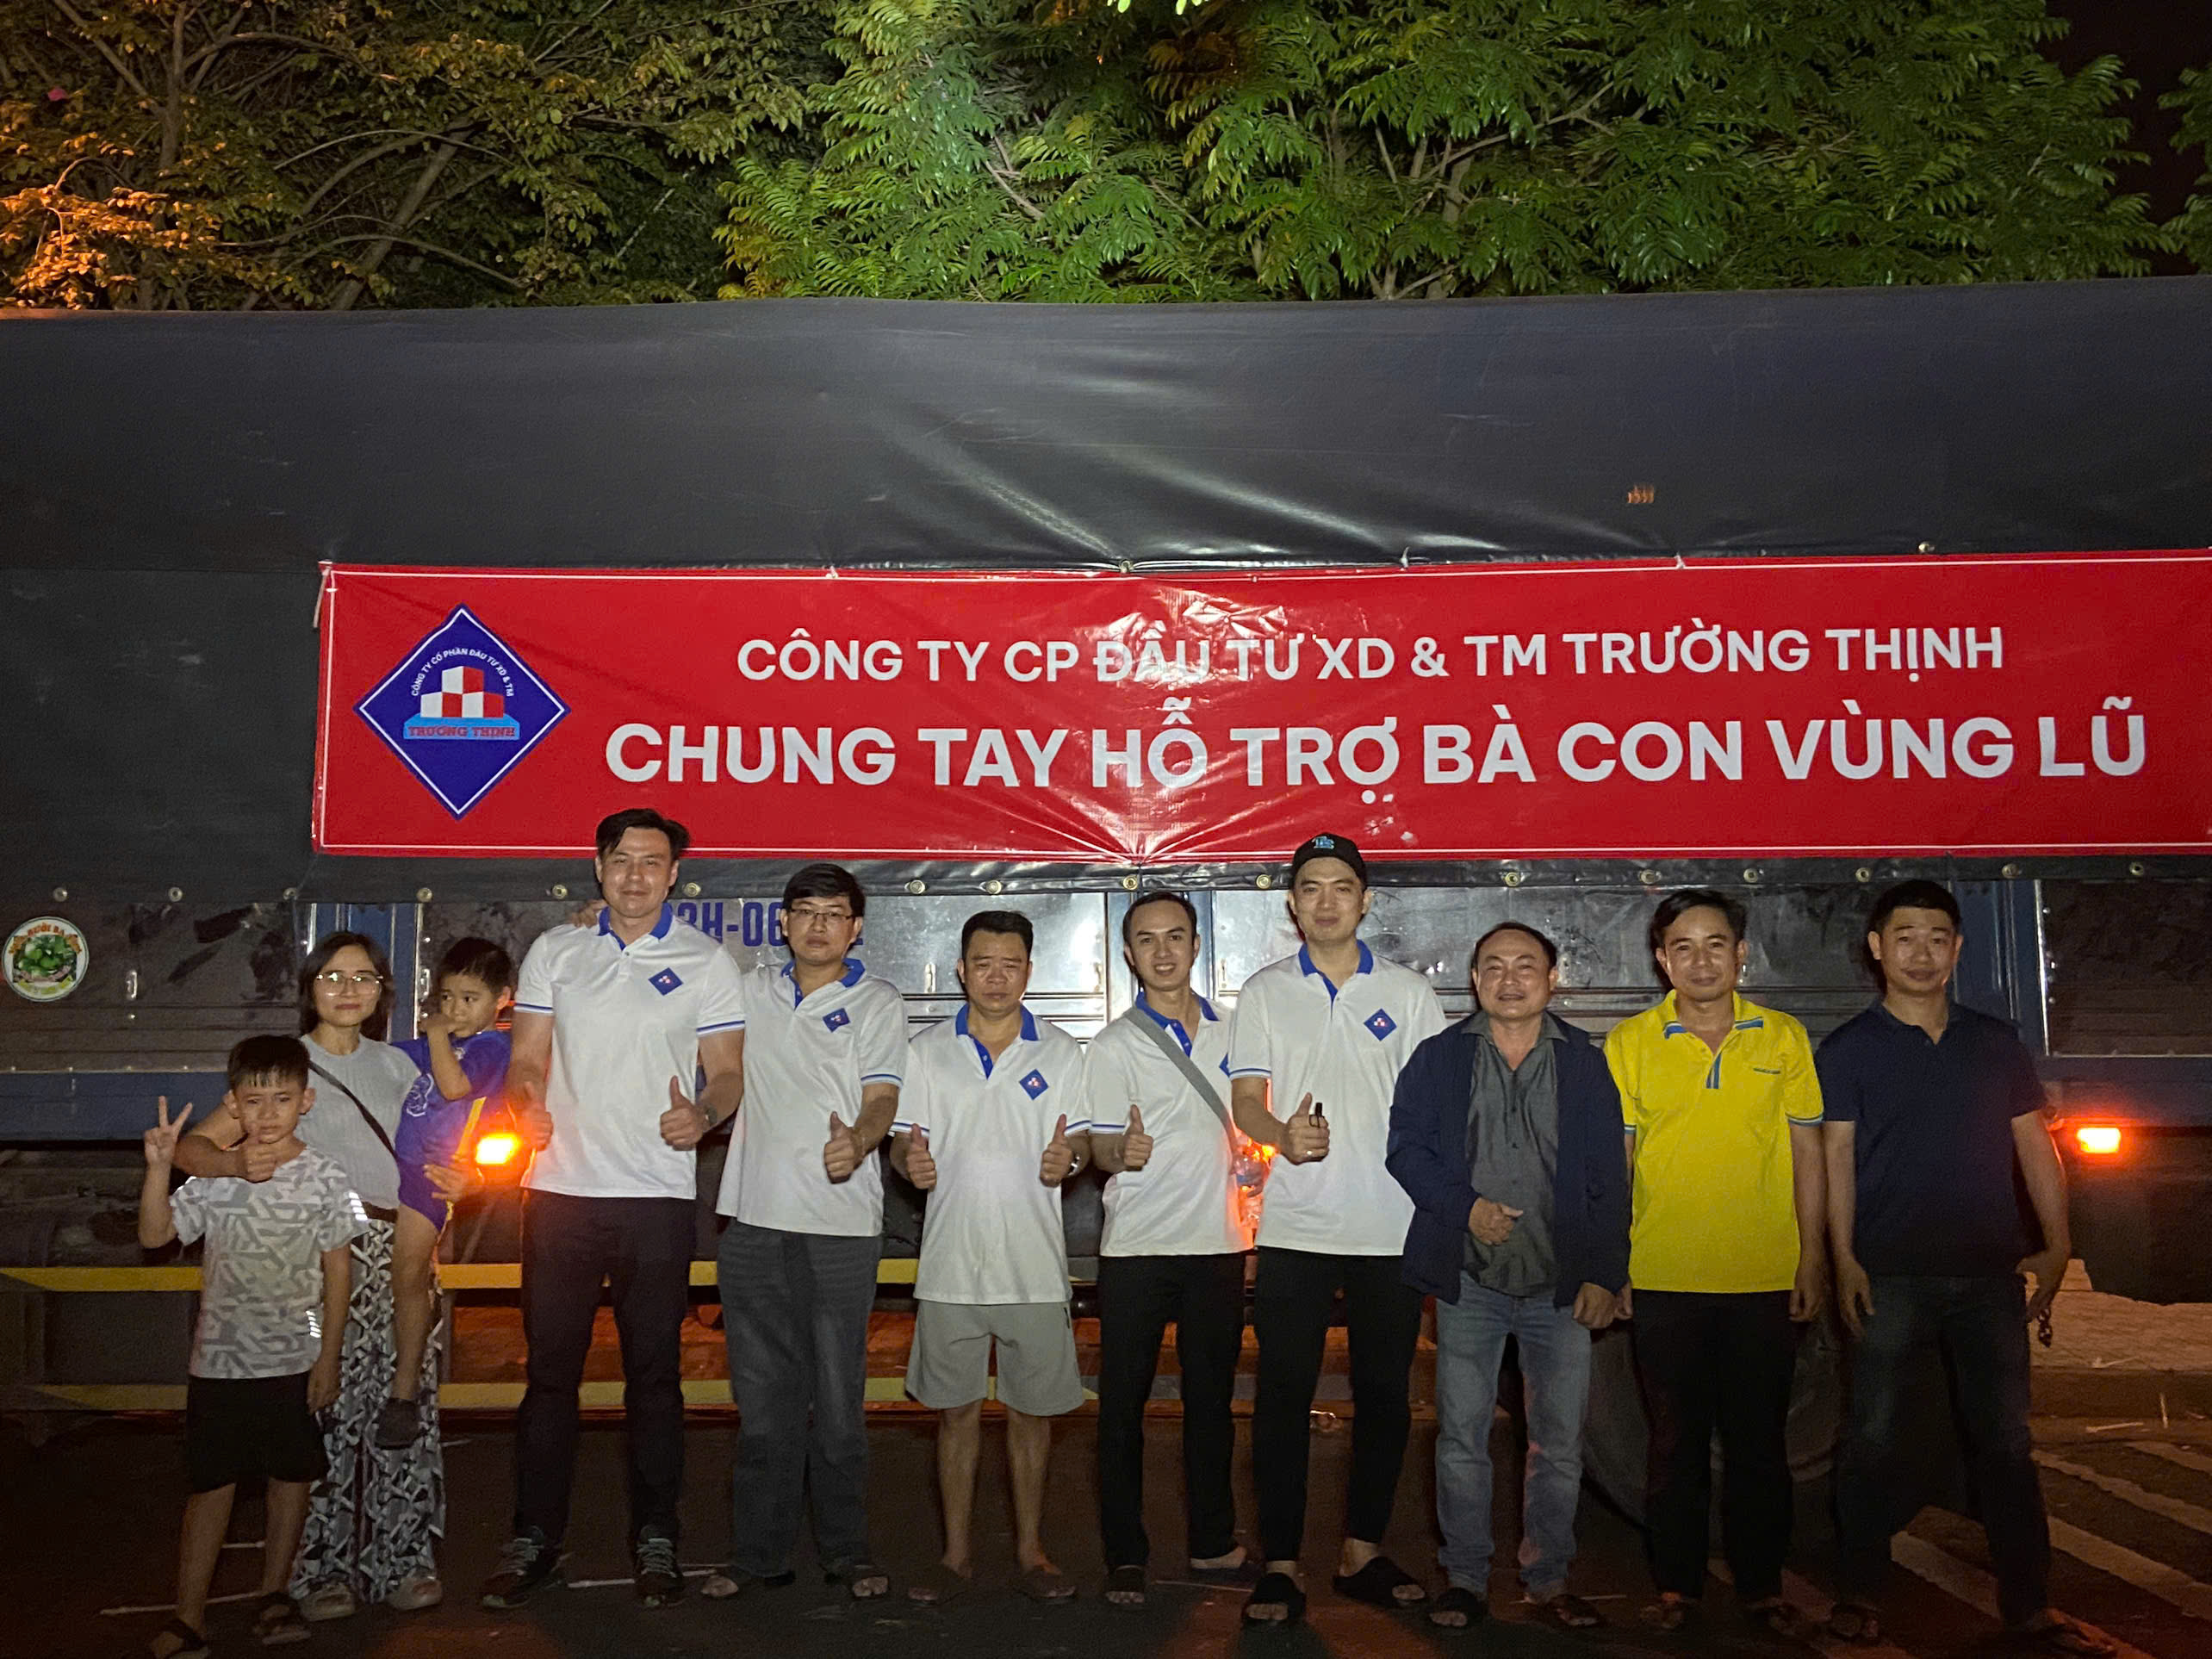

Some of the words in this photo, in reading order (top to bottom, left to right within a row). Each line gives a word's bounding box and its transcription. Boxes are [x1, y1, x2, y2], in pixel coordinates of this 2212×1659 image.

[421, 662, 432, 673] TY
[505, 683, 514, 697] TM
[737, 628, 904, 681] CÔNG
[917, 640, 990, 681] TY
[1003, 640, 1078, 681] CP
[1226, 632, 1305, 681] TƯ
[1316, 637, 1395, 680] XD
[1411, 637, 1449, 678] &
[1464, 633, 1548, 677] TM
[1562, 617, 1809, 674] TRƯỜNG
[1824, 626, 2003, 682] THỊNH
[606, 723, 897, 786] CHUNG
[916, 728, 1069, 787] TAY
[1092, 696, 1208, 788] HỖ
[1230, 716, 1400, 805] TRỢ
[1423, 704, 1537, 783] BÀ
[1557, 719, 1743, 782] CON
[1765, 699, 2016, 779] VÙNG
[2037, 697, 2146, 778] LŨ
